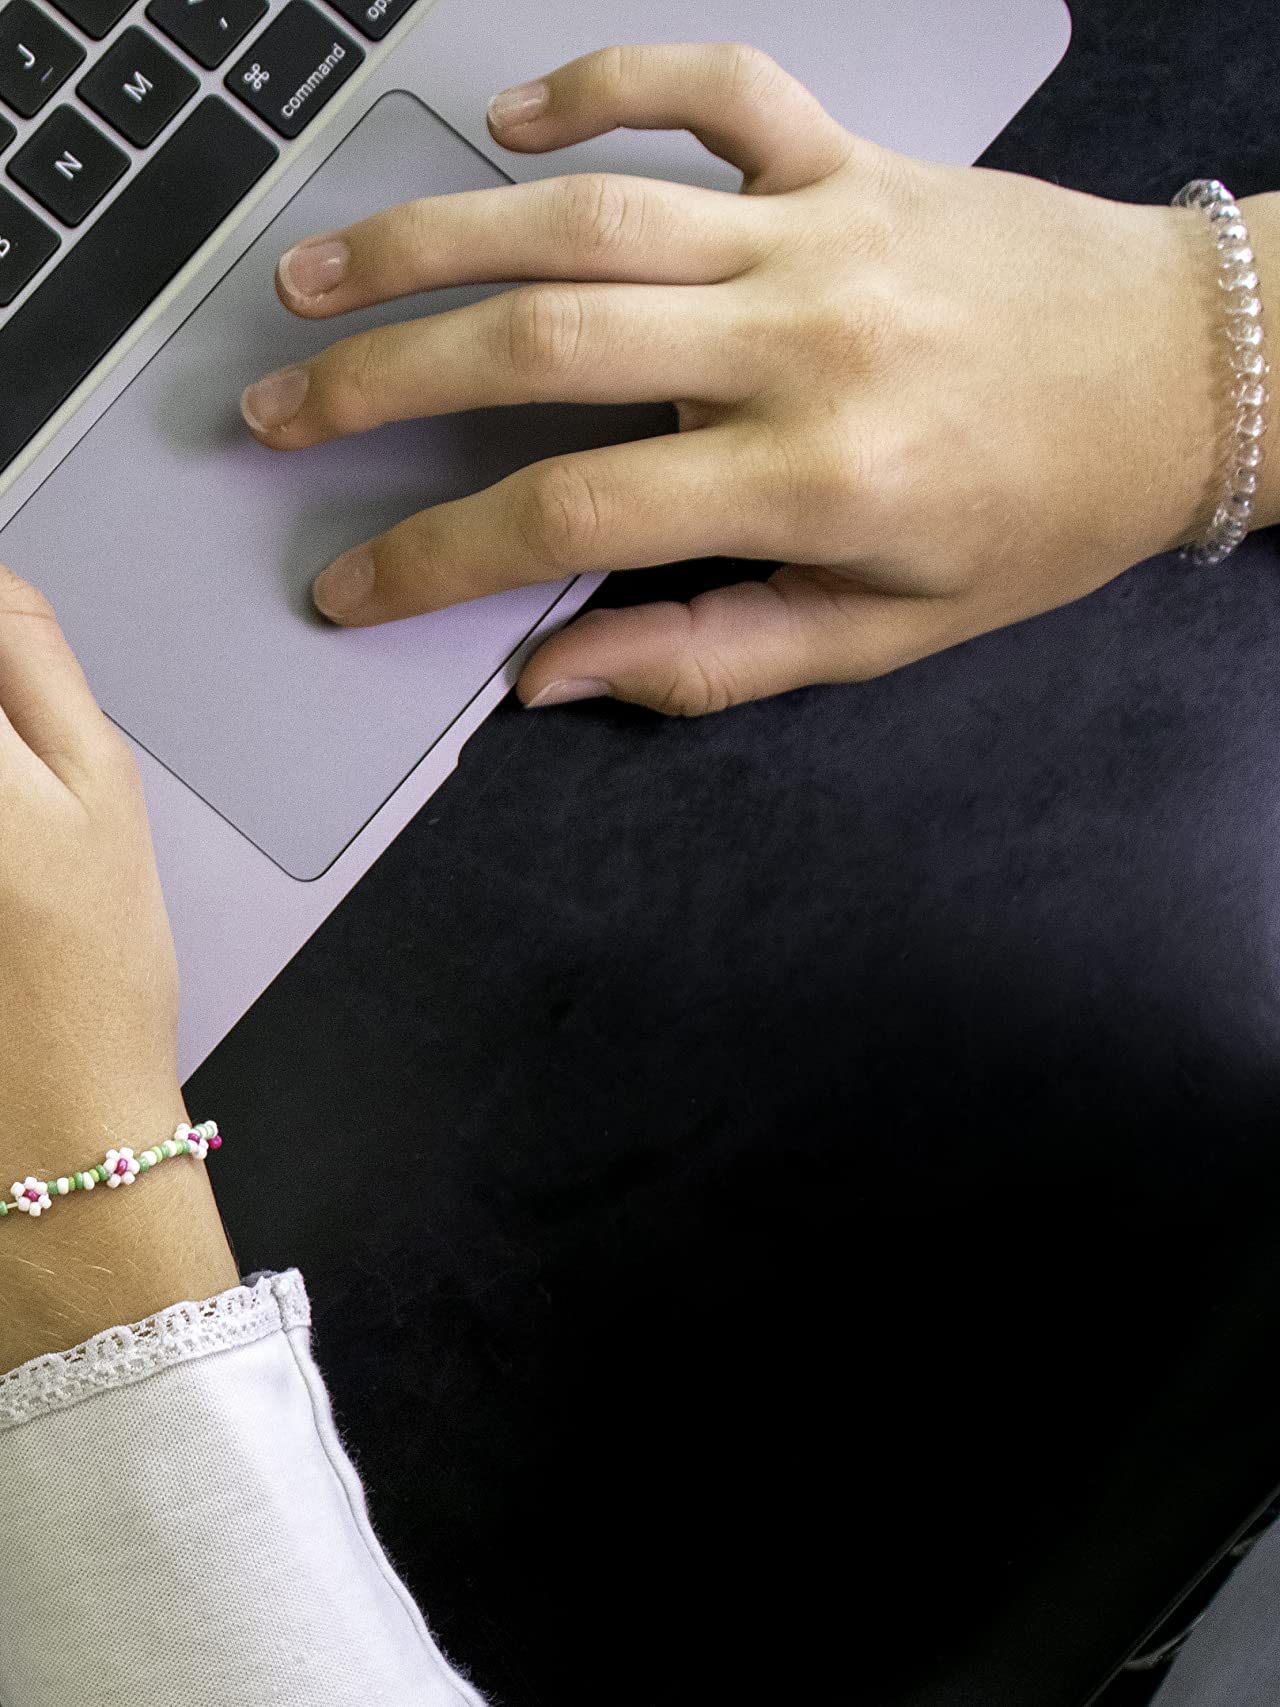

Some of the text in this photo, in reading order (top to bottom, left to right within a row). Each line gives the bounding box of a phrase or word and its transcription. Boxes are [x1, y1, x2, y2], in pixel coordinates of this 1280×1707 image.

[18, 43, 36, 68] J
[123, 71, 153, 102] M
[281, 42, 347, 120] command
[54, 150, 83, 179] N
